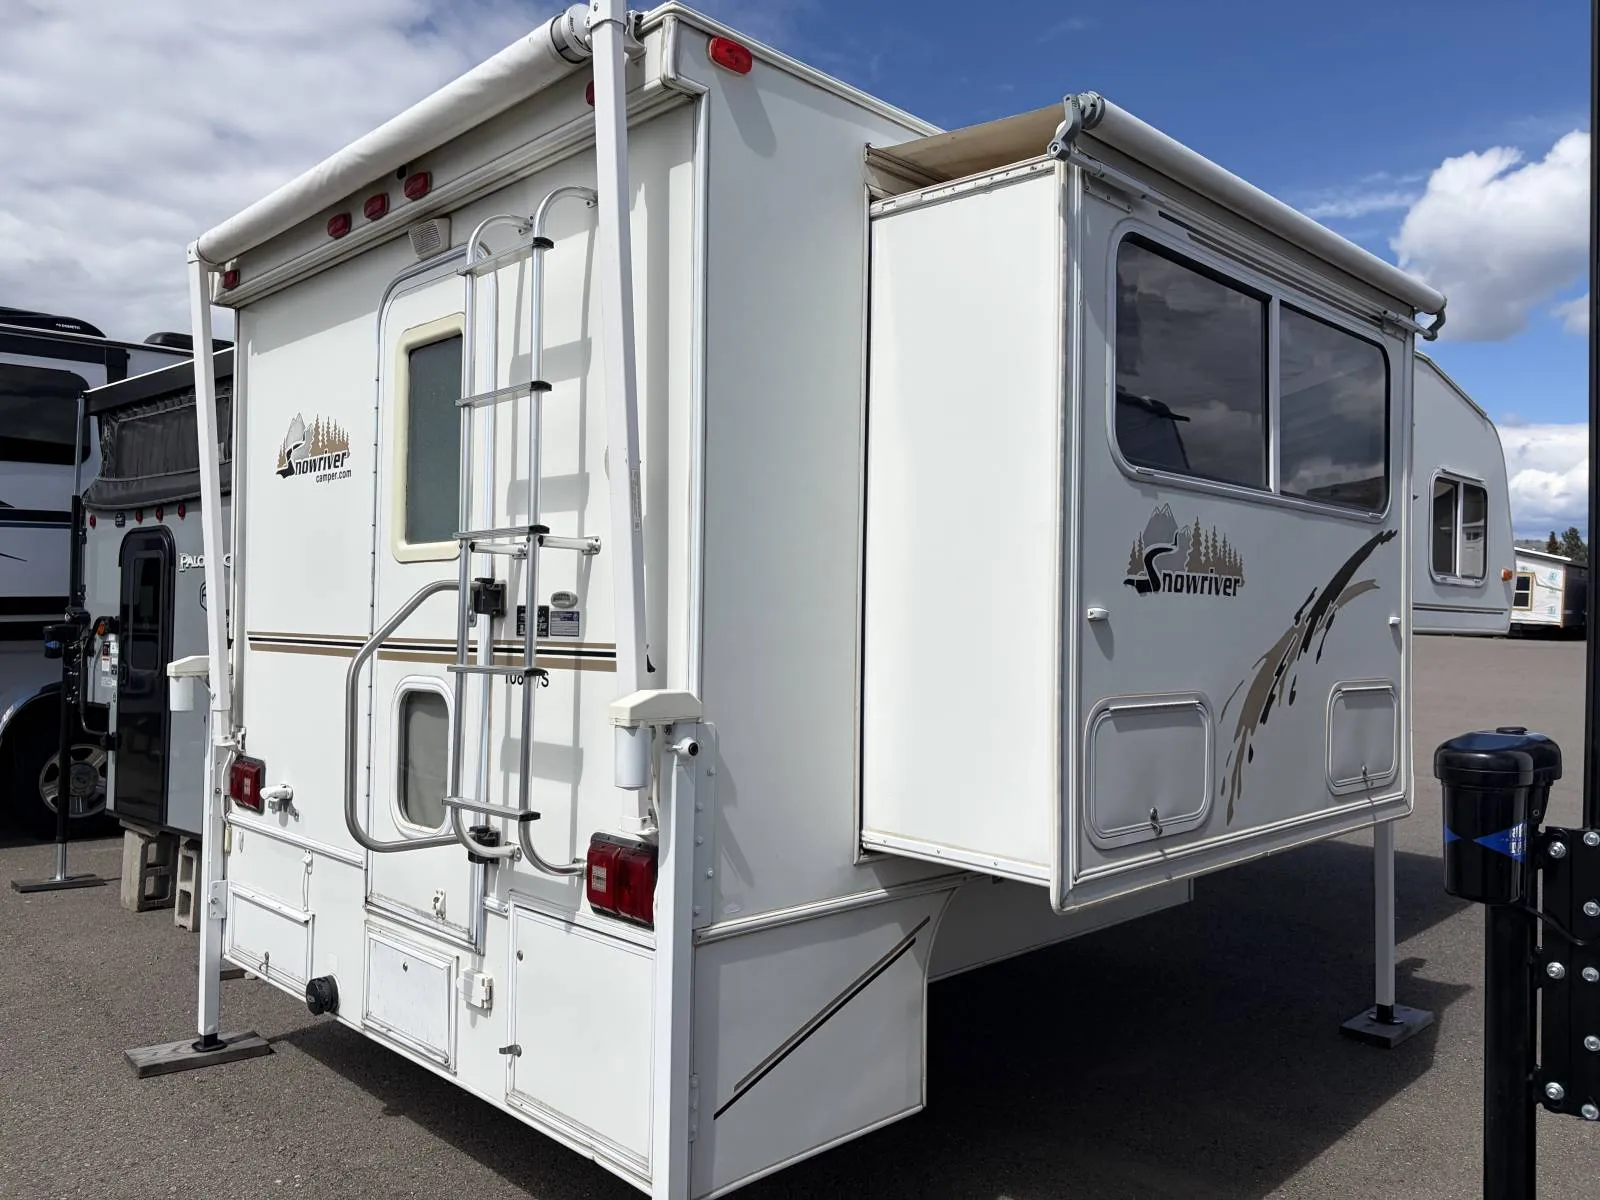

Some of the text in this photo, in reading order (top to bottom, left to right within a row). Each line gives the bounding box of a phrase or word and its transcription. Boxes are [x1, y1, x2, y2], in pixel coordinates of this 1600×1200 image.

[276, 442, 347, 478] Snowriver
[315, 469, 352, 484] camper.com
[1123, 546, 1241, 597] Snowriver
